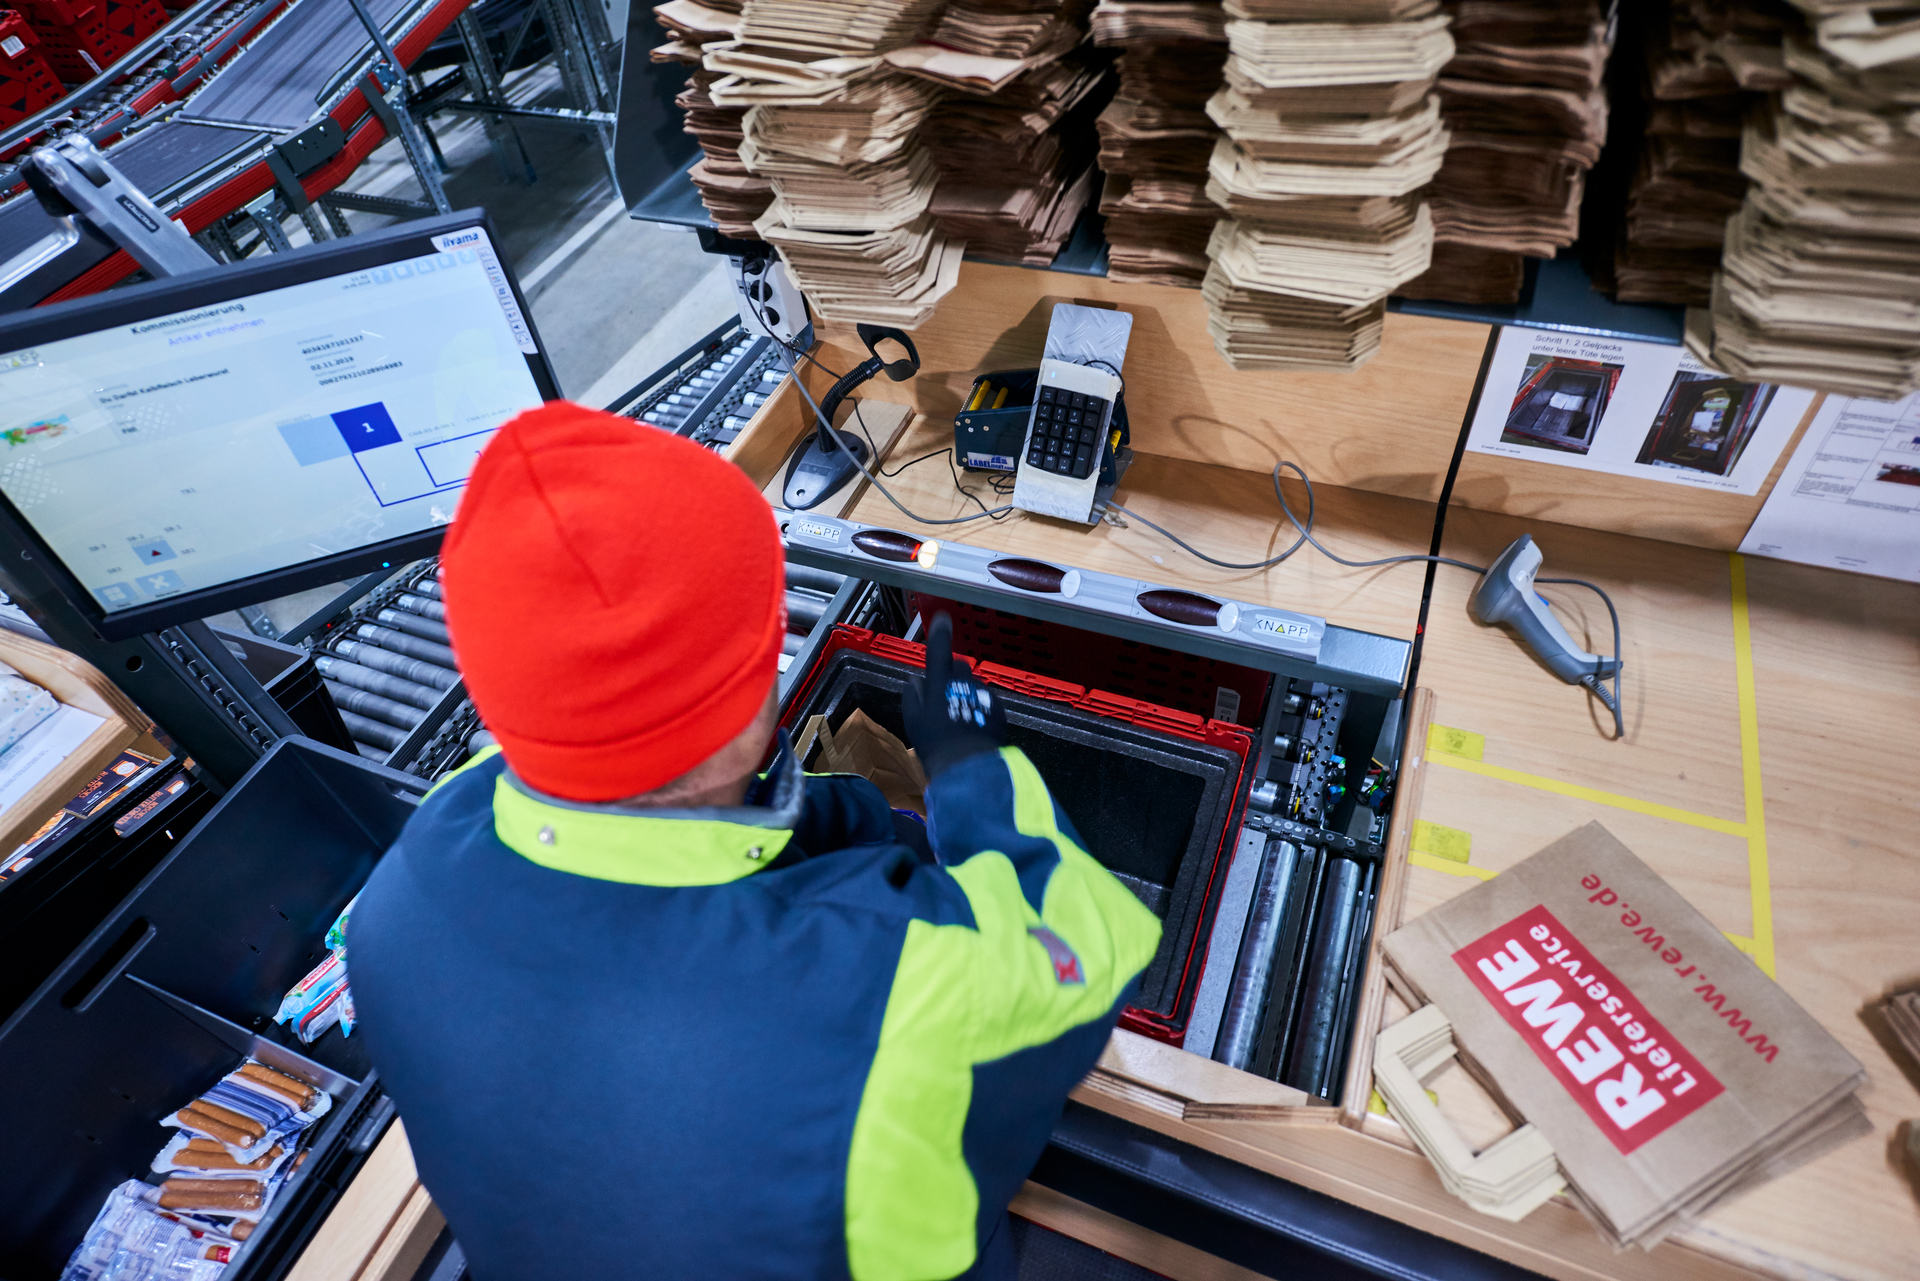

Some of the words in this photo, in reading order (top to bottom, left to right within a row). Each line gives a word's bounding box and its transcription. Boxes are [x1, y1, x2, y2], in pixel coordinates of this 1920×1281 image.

[130, 302, 246, 335] Kommissionierung
[168, 331, 203, 346] Artikel
[1535, 334, 1563, 344] Schritt
[1582, 340, 1623, 352] Gelpacks
[1532, 344, 1554, 352] unter
[1555, 346, 1578, 355] leere
[1580, 349, 1599, 358] Tüte
[1600, 352, 1625, 362] legen
[362, 422, 375, 433] 1
[798, 522, 840, 538] KNAPP
[1255, 618, 1309, 637] KNAPP
[1580, 873, 1780, 1063] www.rewe.de
[1528, 922, 1698, 1097] Lieferservice
[1476, 938, 1667, 1131] REWE
